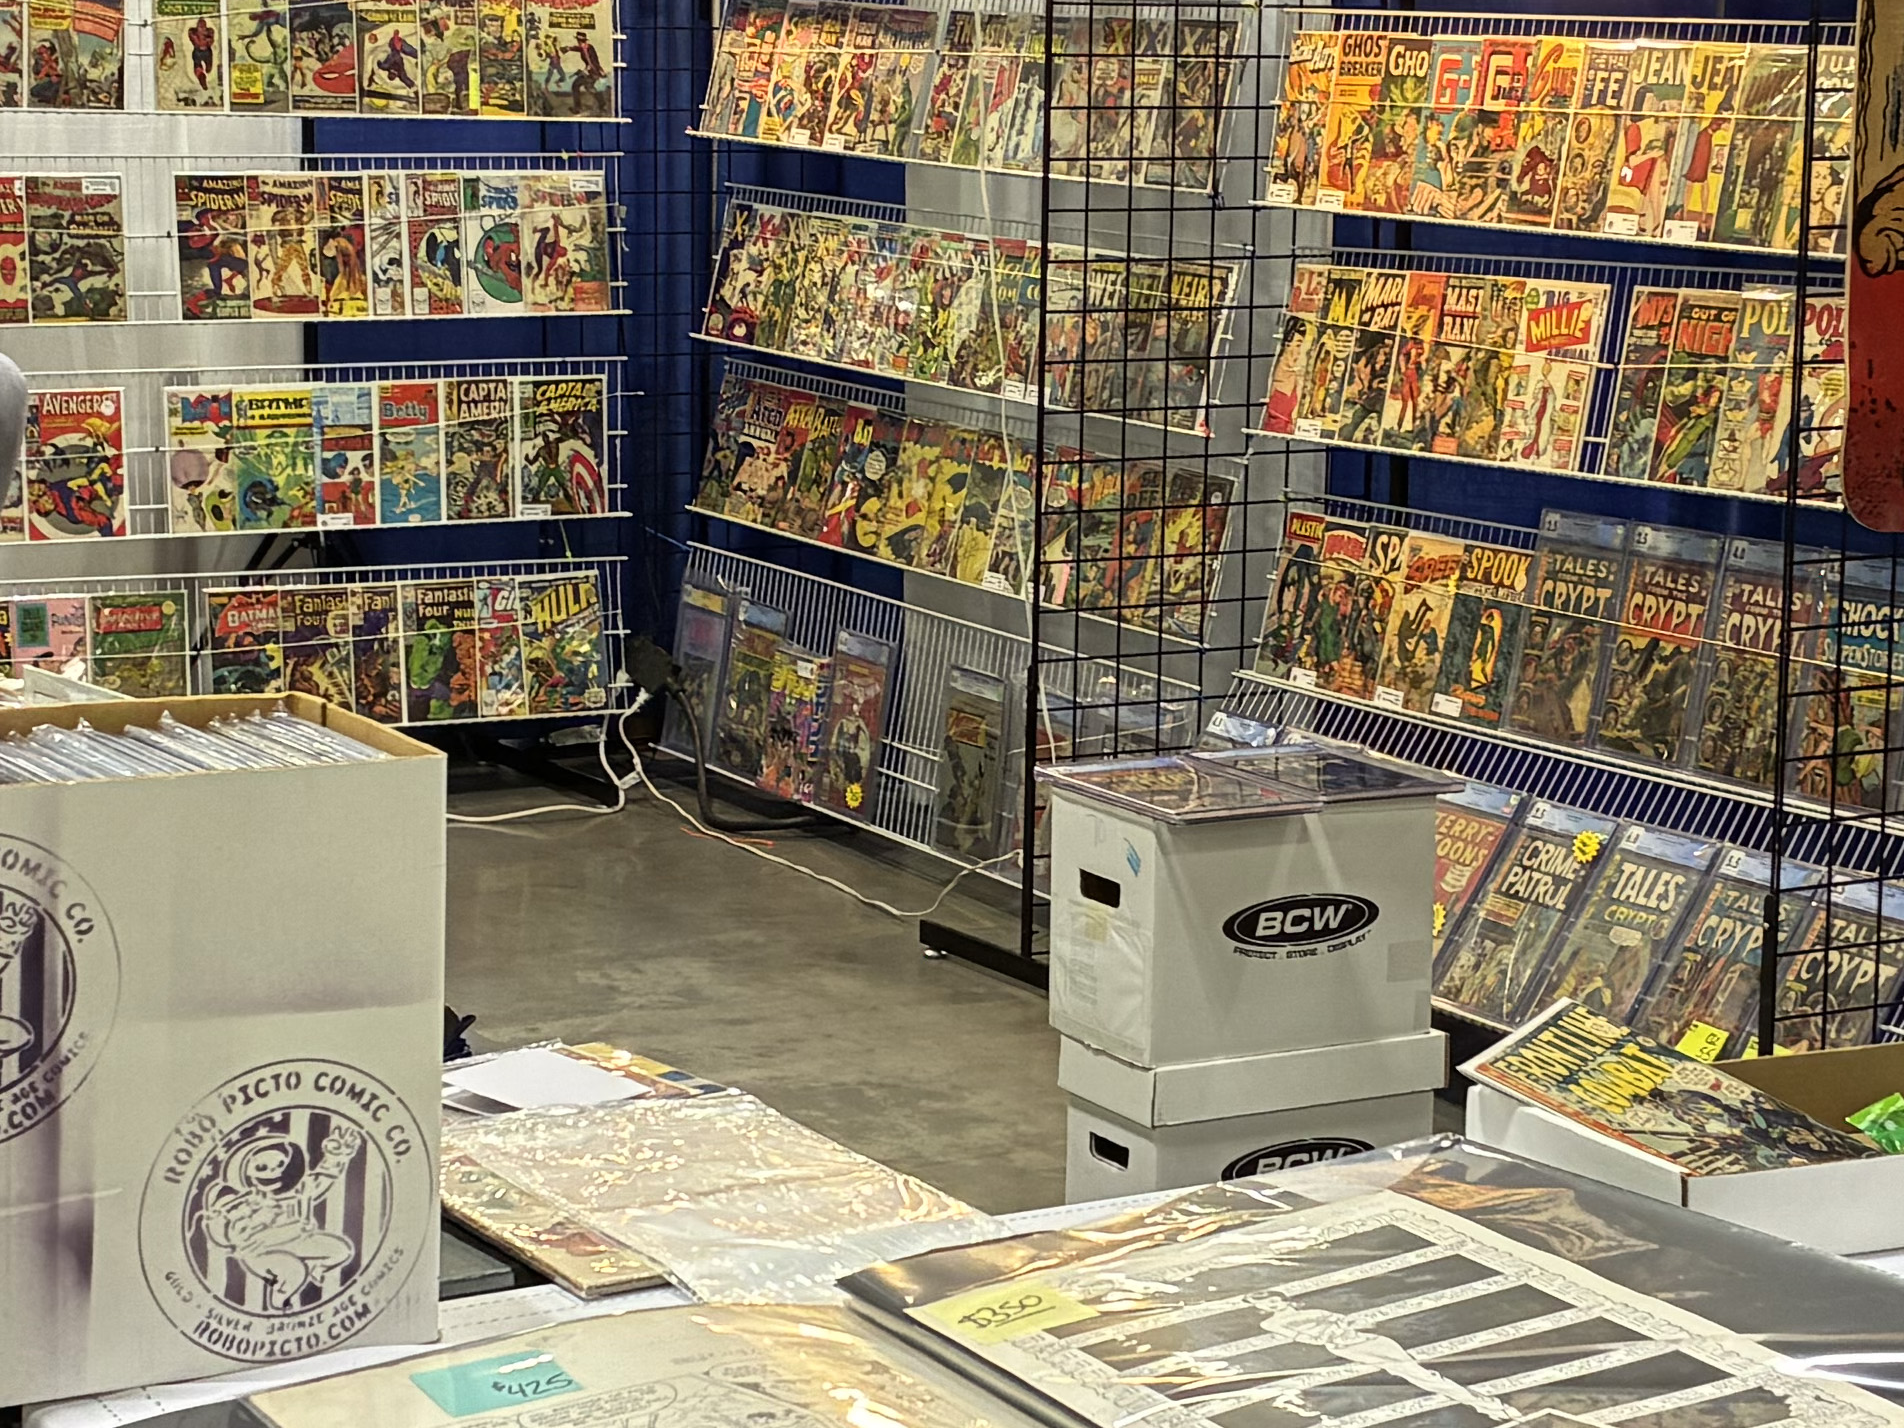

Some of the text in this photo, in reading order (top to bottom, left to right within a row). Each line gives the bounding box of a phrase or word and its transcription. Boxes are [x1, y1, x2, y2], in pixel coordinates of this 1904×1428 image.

[1529, 303, 1591, 345] MILLIE
[1554, 556, 1608, 575] TALES
[1644, 565, 1701, 594] TALES
[1540, 582, 1612, 617] CRYPT
[1628, 593, 1704, 633] CRYPT
[1613, 862, 1685, 912] TALES
[1254, 903, 1349, 937] BCW
[217, 1070, 302, 1113] PICTO
[312, 1070, 388, 1123] COMIC
[191, 1299, 373, 1359] ROBOPICTO.COM
